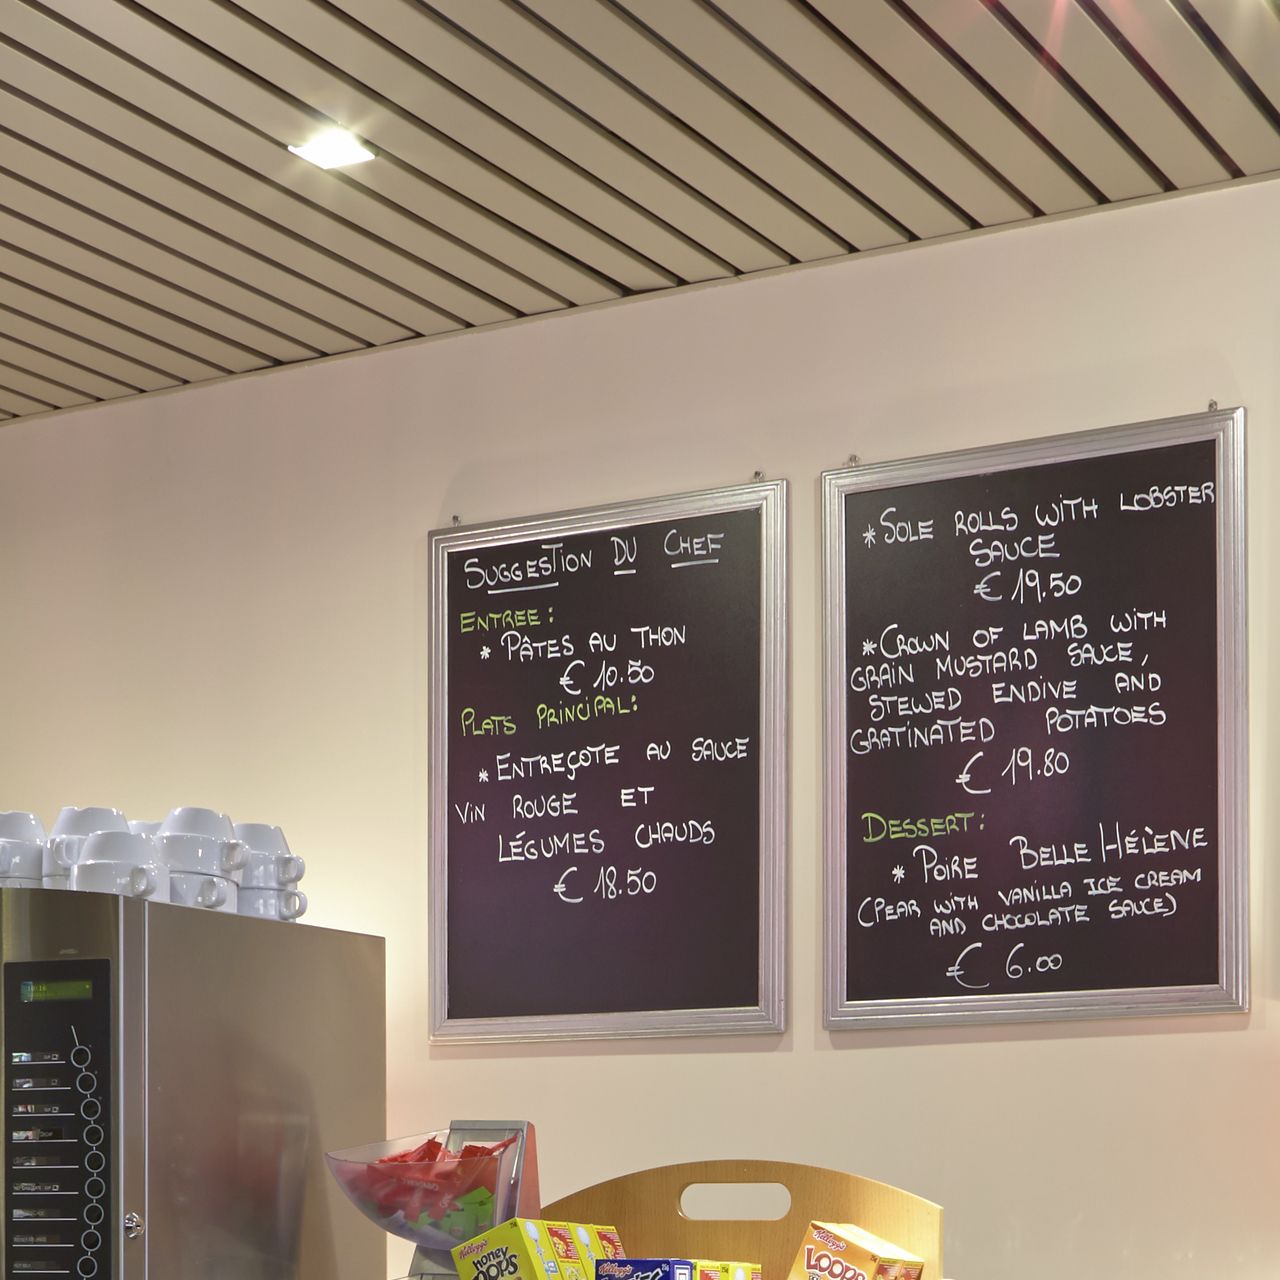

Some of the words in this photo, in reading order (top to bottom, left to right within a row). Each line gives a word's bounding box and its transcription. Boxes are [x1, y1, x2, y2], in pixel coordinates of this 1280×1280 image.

[955, 507, 1018, 536] ROLLS
[1035, 494, 1098, 526] WITH
[1120, 482, 1214, 510] LOBSTER
[464, 543, 592, 589] SUGGESTION
[611, 537, 636, 565] DU
[664, 529, 724, 555] CHEF
[969, 533, 1060, 567] SAUCE
[501, 631, 574, 662] PÂTES
[589, 632, 616, 652] AU
[631, 625, 685, 648] THON
[973, 627, 1003, 648] OF
[1023, 615, 1087, 640] LAMB
[1110, 608, 1166, 632] WITH
[851, 663, 914, 691] GRAIN
[936, 648, 1037, 680] MUSTARD
[869, 688, 961, 721] STEWED
[992, 676, 1076, 703] ENDIVE
[1115, 672, 1161, 693] AND
[462, 708, 516, 736] PLATS
[850, 713, 994, 754] GRATINATED
[1046, 702, 1166, 735] POTATOES
[647, 741, 670, 760] AU
[692, 737, 749, 761] SAUCE
[455, 802, 485, 824] VIN
[513, 793, 578, 819] ROUGE
[621, 787, 654, 807] ET
[499, 829, 604, 862] LÉGUMES
[635, 820, 715, 848] CHAUDS
[913, 845, 978, 883] POIRE
[1009, 836, 1091, 869] BELLE
[934, 892, 978, 914] WITH
[998, 881, 1071, 906] VANILLA
[1083, 876, 1123, 895] ICE
[1135, 868, 1201, 889] CREAM
[930, 917, 966, 937] AND
[982, 905, 1090, 931] CHOCOLATE
[1109, 892, 1176, 919] SAUCE)
[472, 1246, 509, 1271] honey
[813, 1229, 846, 1251] Kellogg's
[598, 1262, 634, 1278] Kellogg's
